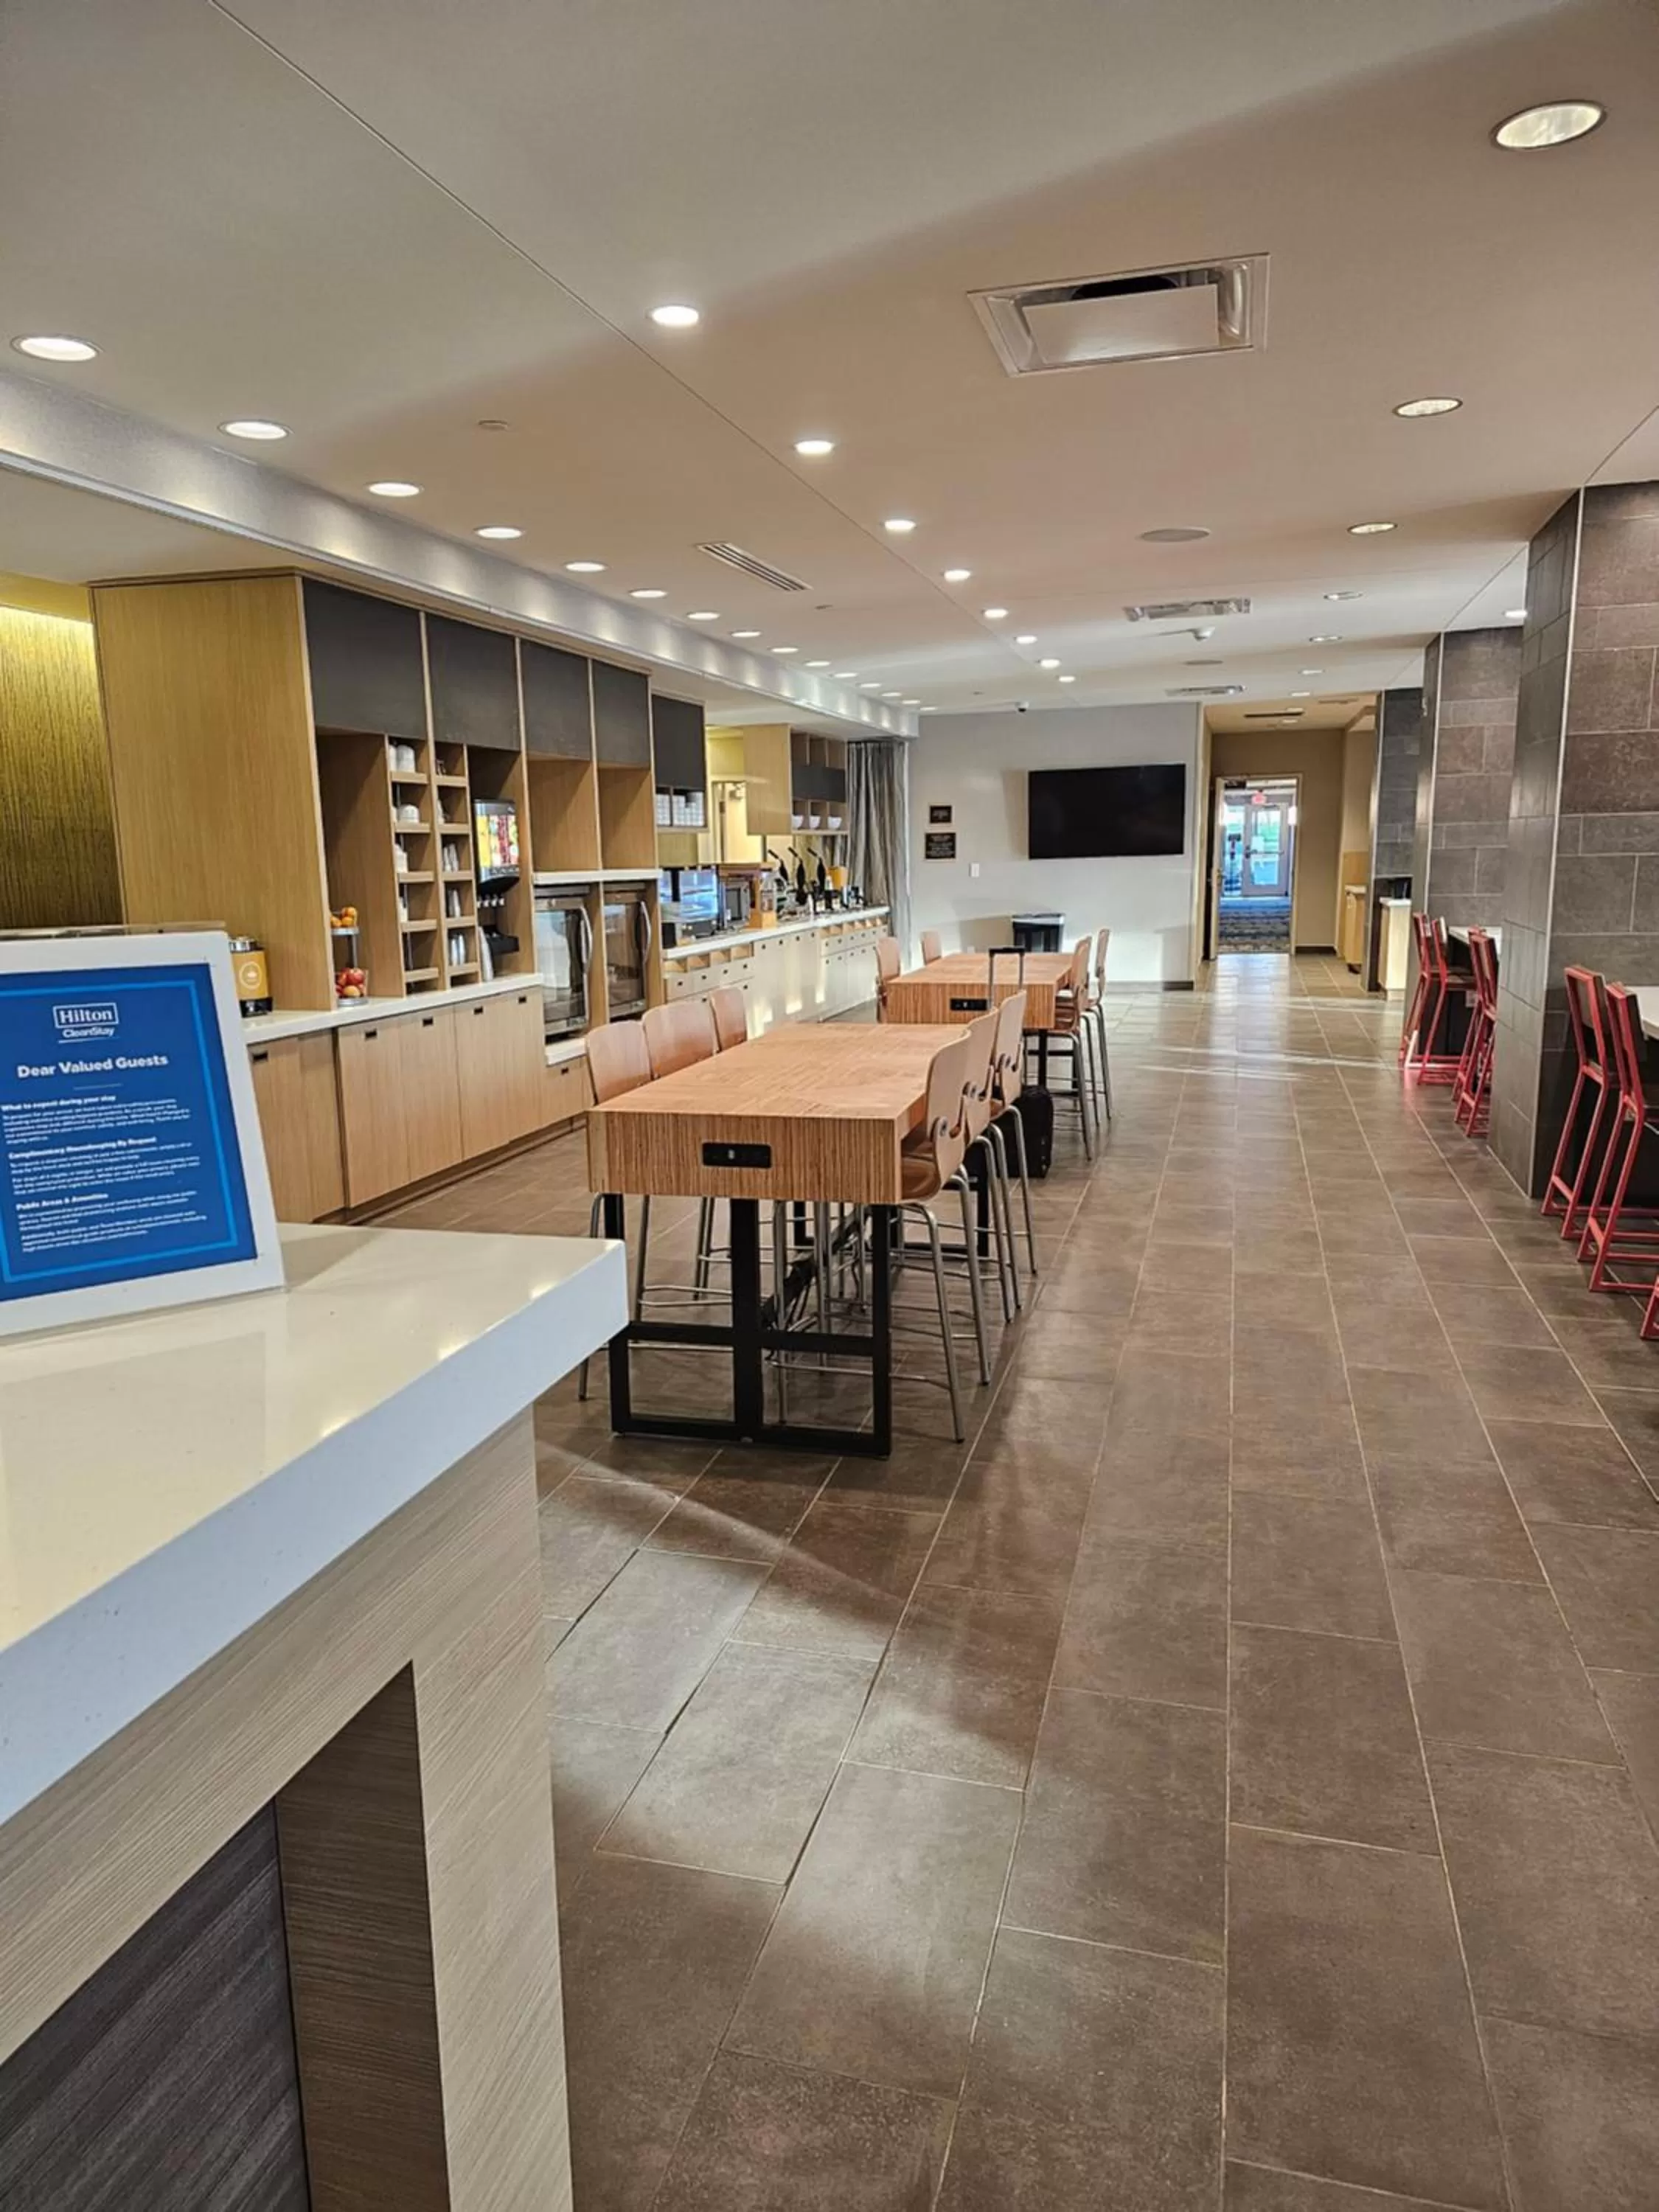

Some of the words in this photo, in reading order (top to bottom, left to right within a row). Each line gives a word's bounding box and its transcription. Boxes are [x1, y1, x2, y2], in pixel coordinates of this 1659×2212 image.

[59, 1009, 112, 1023] Hilton
[17, 1065, 56, 1078] Dear
[58, 1058, 113, 1074] Valued
[115, 1054, 168, 1069] Guests
